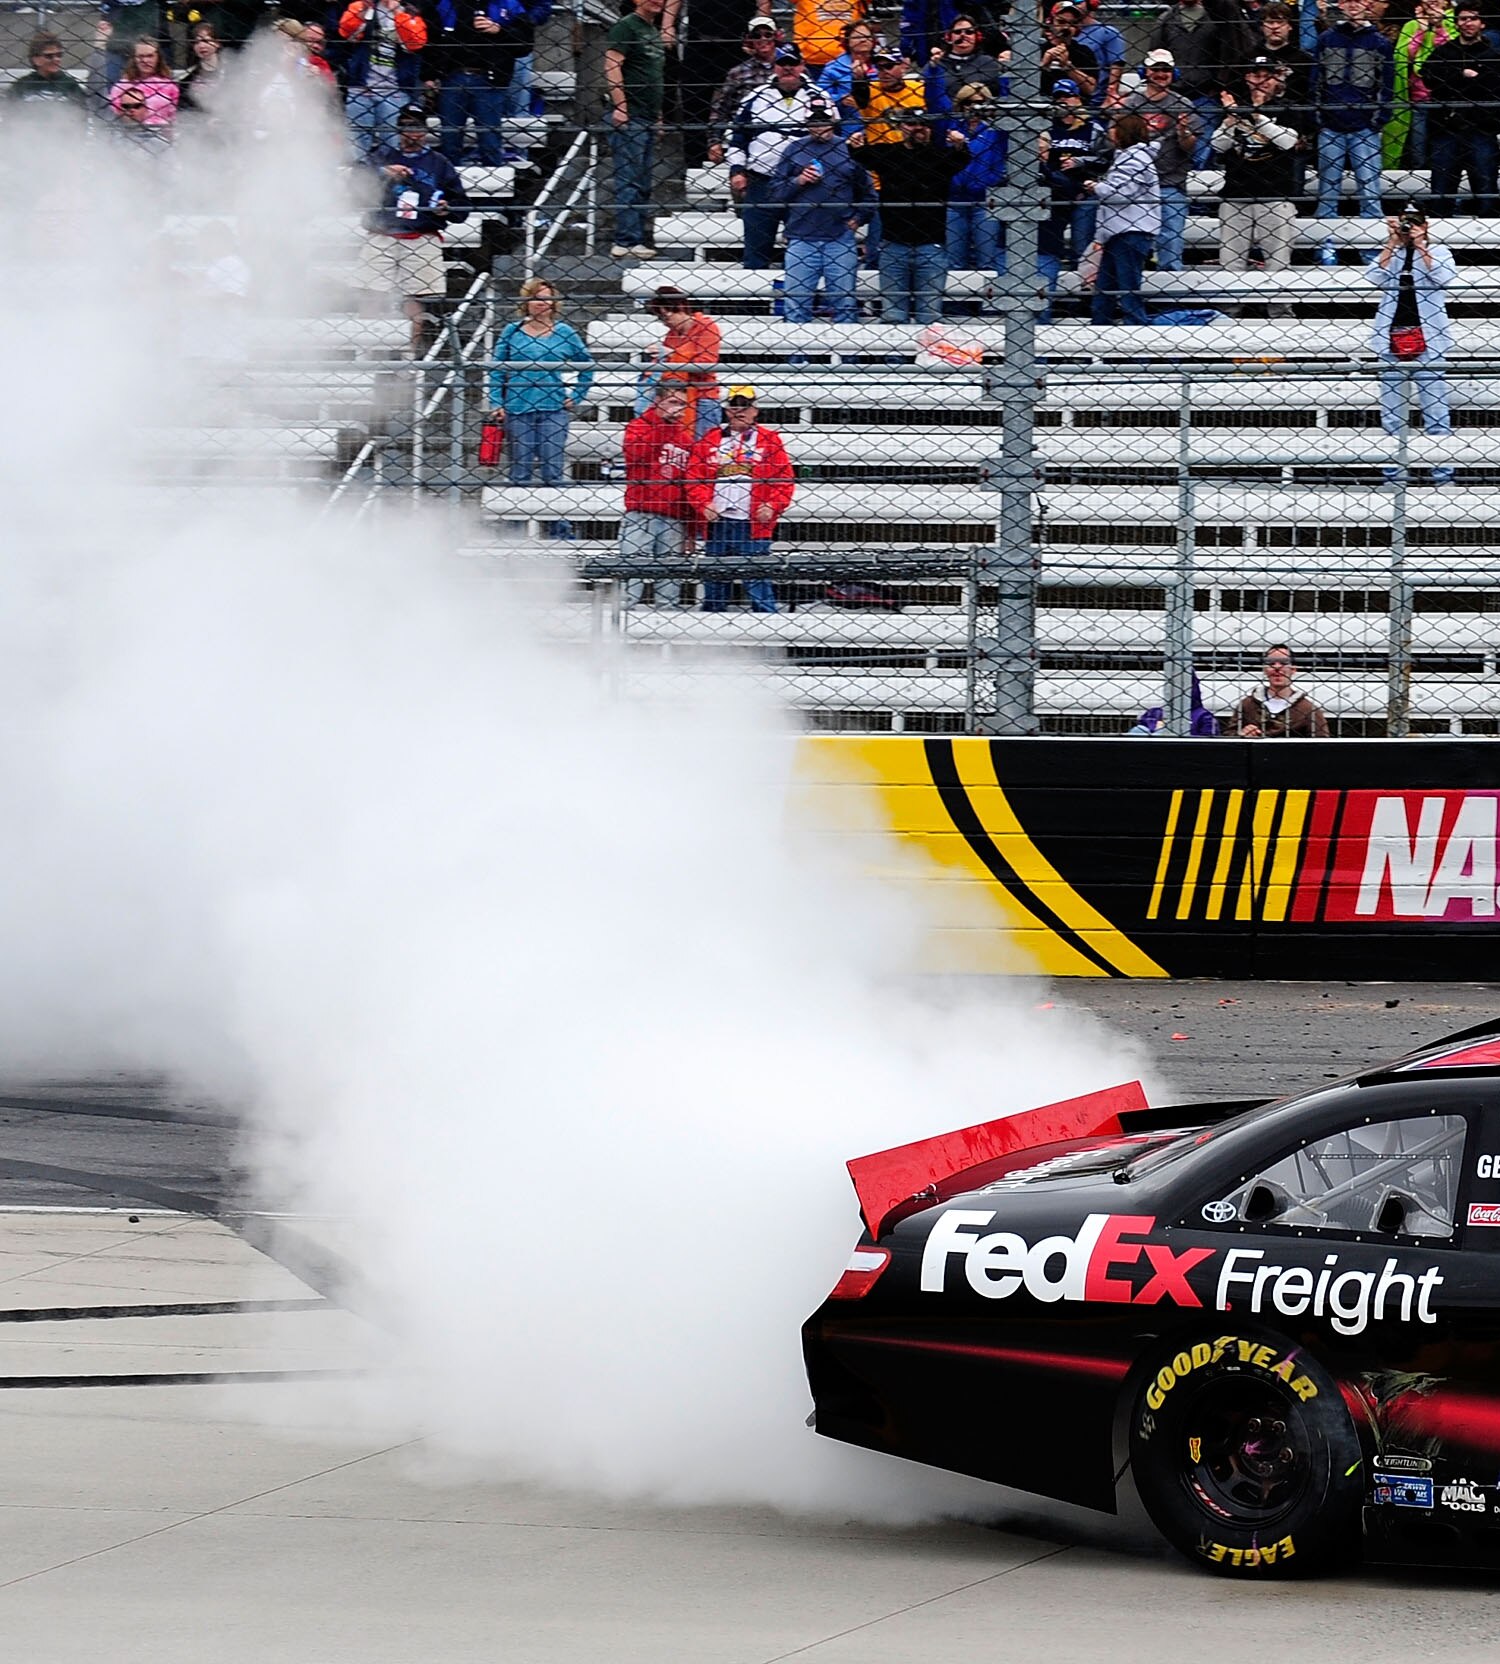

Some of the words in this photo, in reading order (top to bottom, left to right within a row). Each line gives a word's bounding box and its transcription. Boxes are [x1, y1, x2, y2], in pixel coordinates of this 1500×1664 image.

[920, 1209, 1216, 1308] FedEx
[1216, 1248, 1445, 1336] Freight
[1146, 1336, 1319, 1411] GOODYEAR
[1207, 1534, 1296, 1567] EAGLE
